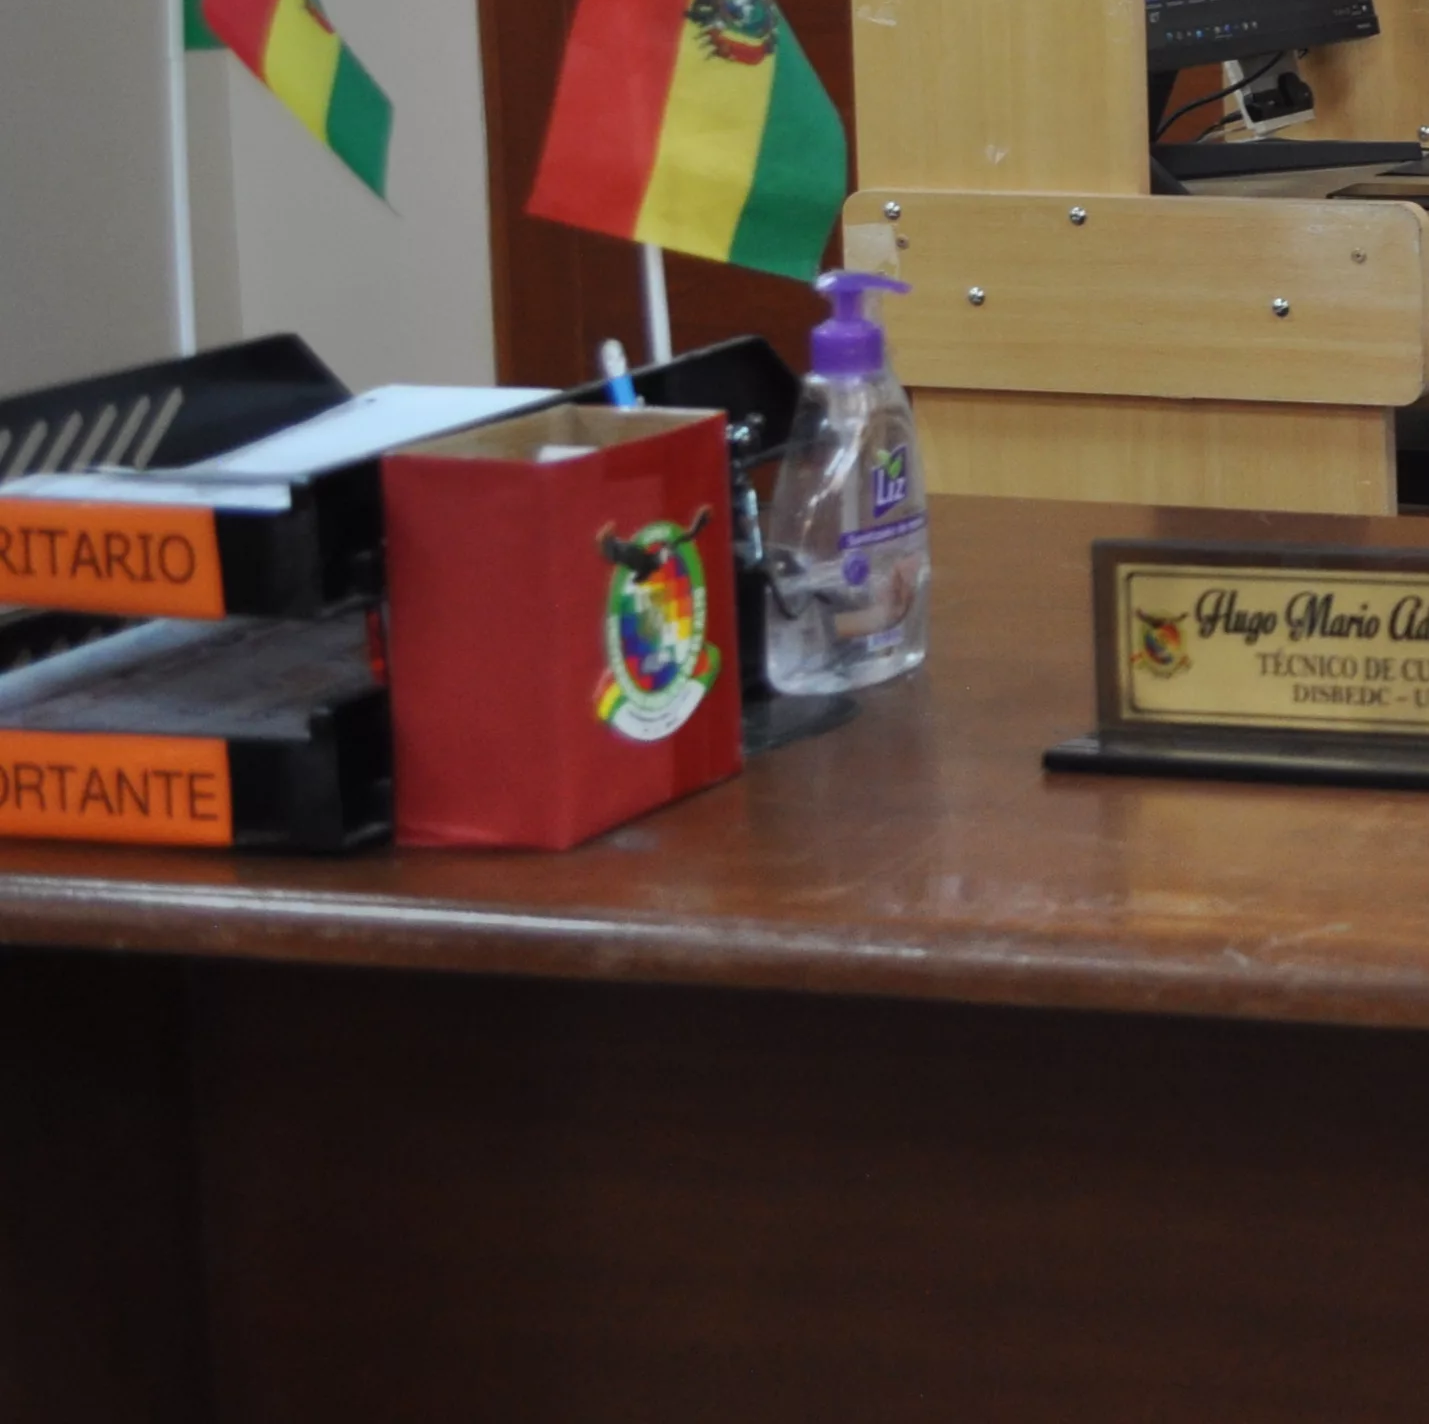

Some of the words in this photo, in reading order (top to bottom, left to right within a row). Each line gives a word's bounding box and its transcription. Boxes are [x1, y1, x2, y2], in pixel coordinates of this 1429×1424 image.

[1194, 588, 1277, 646] Hugo
[1285, 590, 1381, 642] Mario
[1256, 649, 1358, 679] TÉCNICO
[1365, 657, 1394, 682] DE
[1293, 683, 1391, 707] DISBEDC
[0, 762, 218, 822] RTANTE
